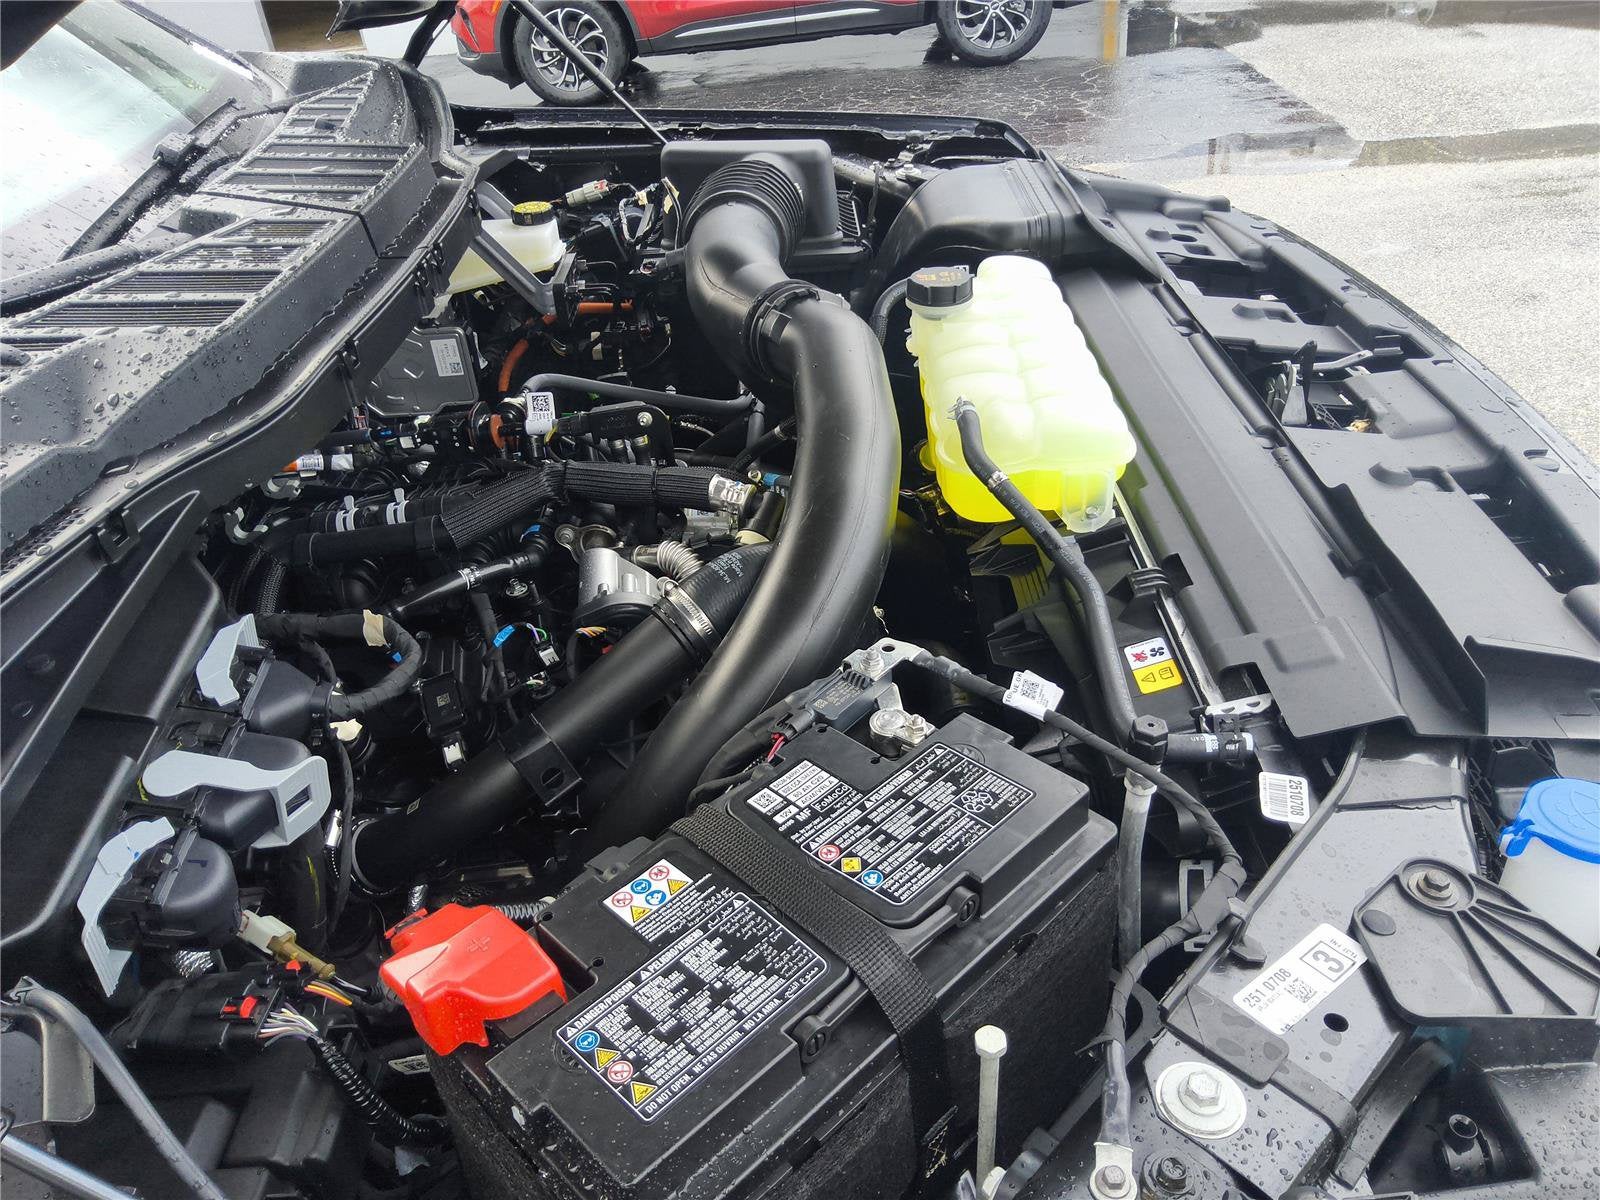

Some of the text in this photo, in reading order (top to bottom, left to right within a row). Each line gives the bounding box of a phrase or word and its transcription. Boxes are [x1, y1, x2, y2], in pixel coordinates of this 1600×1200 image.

[795, 807, 812, 821] MF
[814, 784, 848, 809] FoMoCo
[1289, 779, 1304, 817] 2510708
[646, 928, 704, 972] PELIGRO/VENENO
[1312, 949, 1345, 974] 3
[572, 980, 636, 1029] DANGER/POISON
[1242, 988, 1266, 1008] 251
[1262, 967, 1292, 991] 0708
[742, 995, 782, 1030] NO LA ABRA.
[692, 1028, 743, 1073] NE PAS OUVRIR.
[644, 1071, 693, 1114] DO NOT OPEN.
